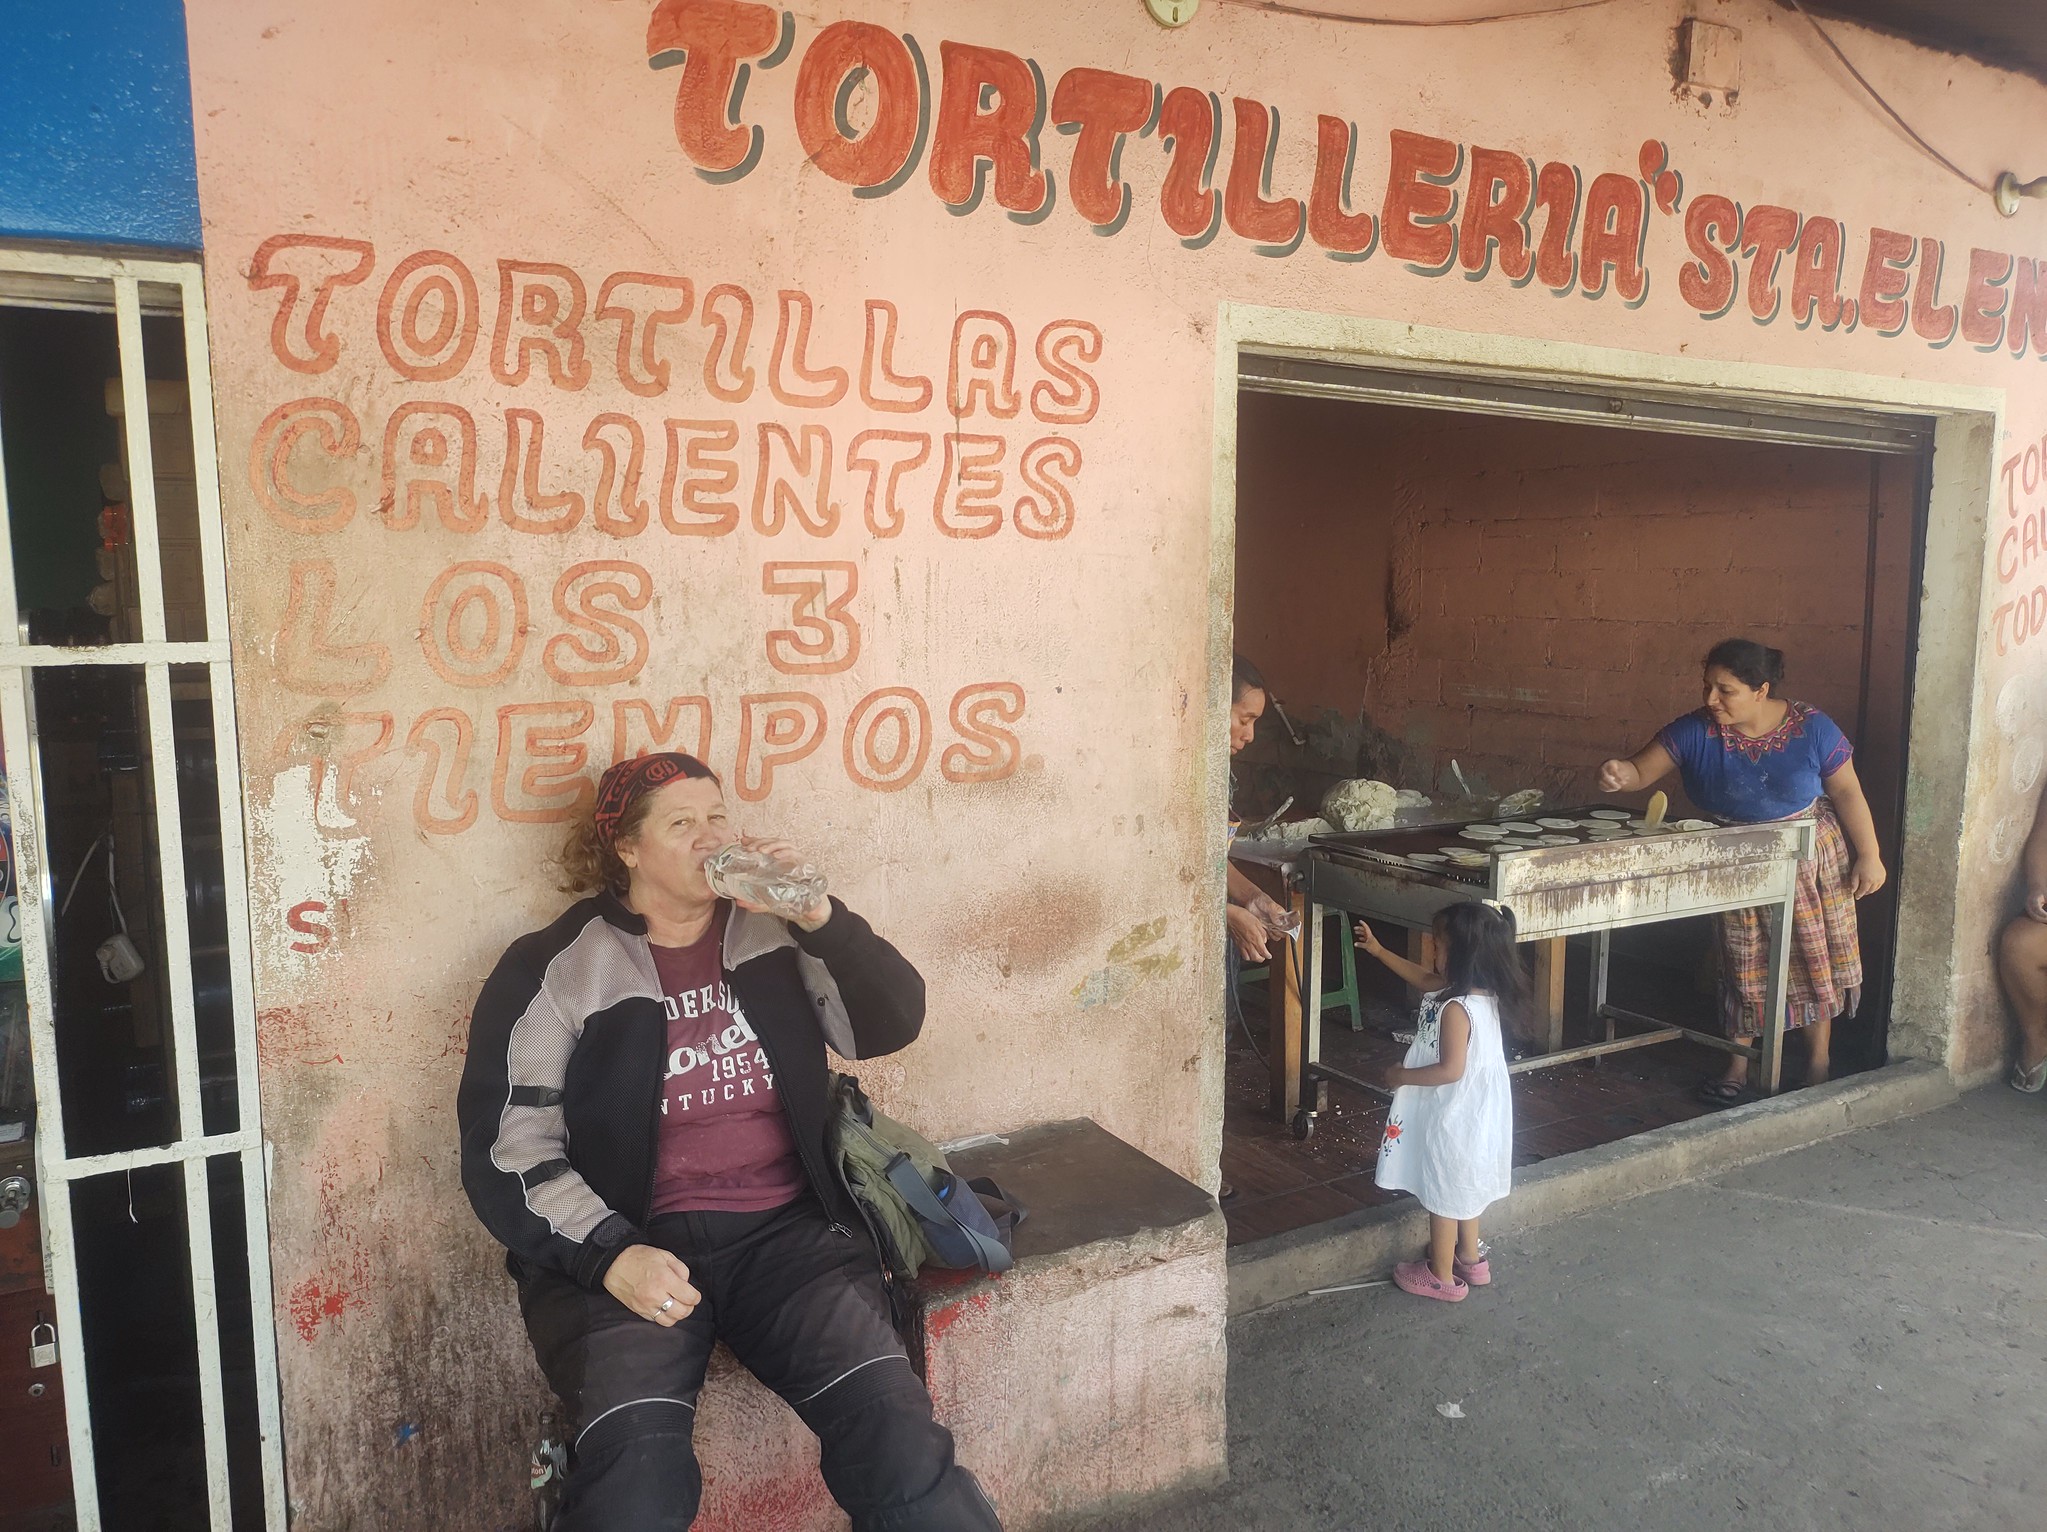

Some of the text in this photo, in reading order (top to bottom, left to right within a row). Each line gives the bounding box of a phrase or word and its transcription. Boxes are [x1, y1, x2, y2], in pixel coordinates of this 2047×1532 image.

[247, 233, 1103, 424] TORTILLAS
[249, 396, 1083, 539] CALIENTES
[270, 560, 861, 697] LOS 3
[663, 1009, 759, 1080] onel
[712, 1047, 771, 1082] 1954
